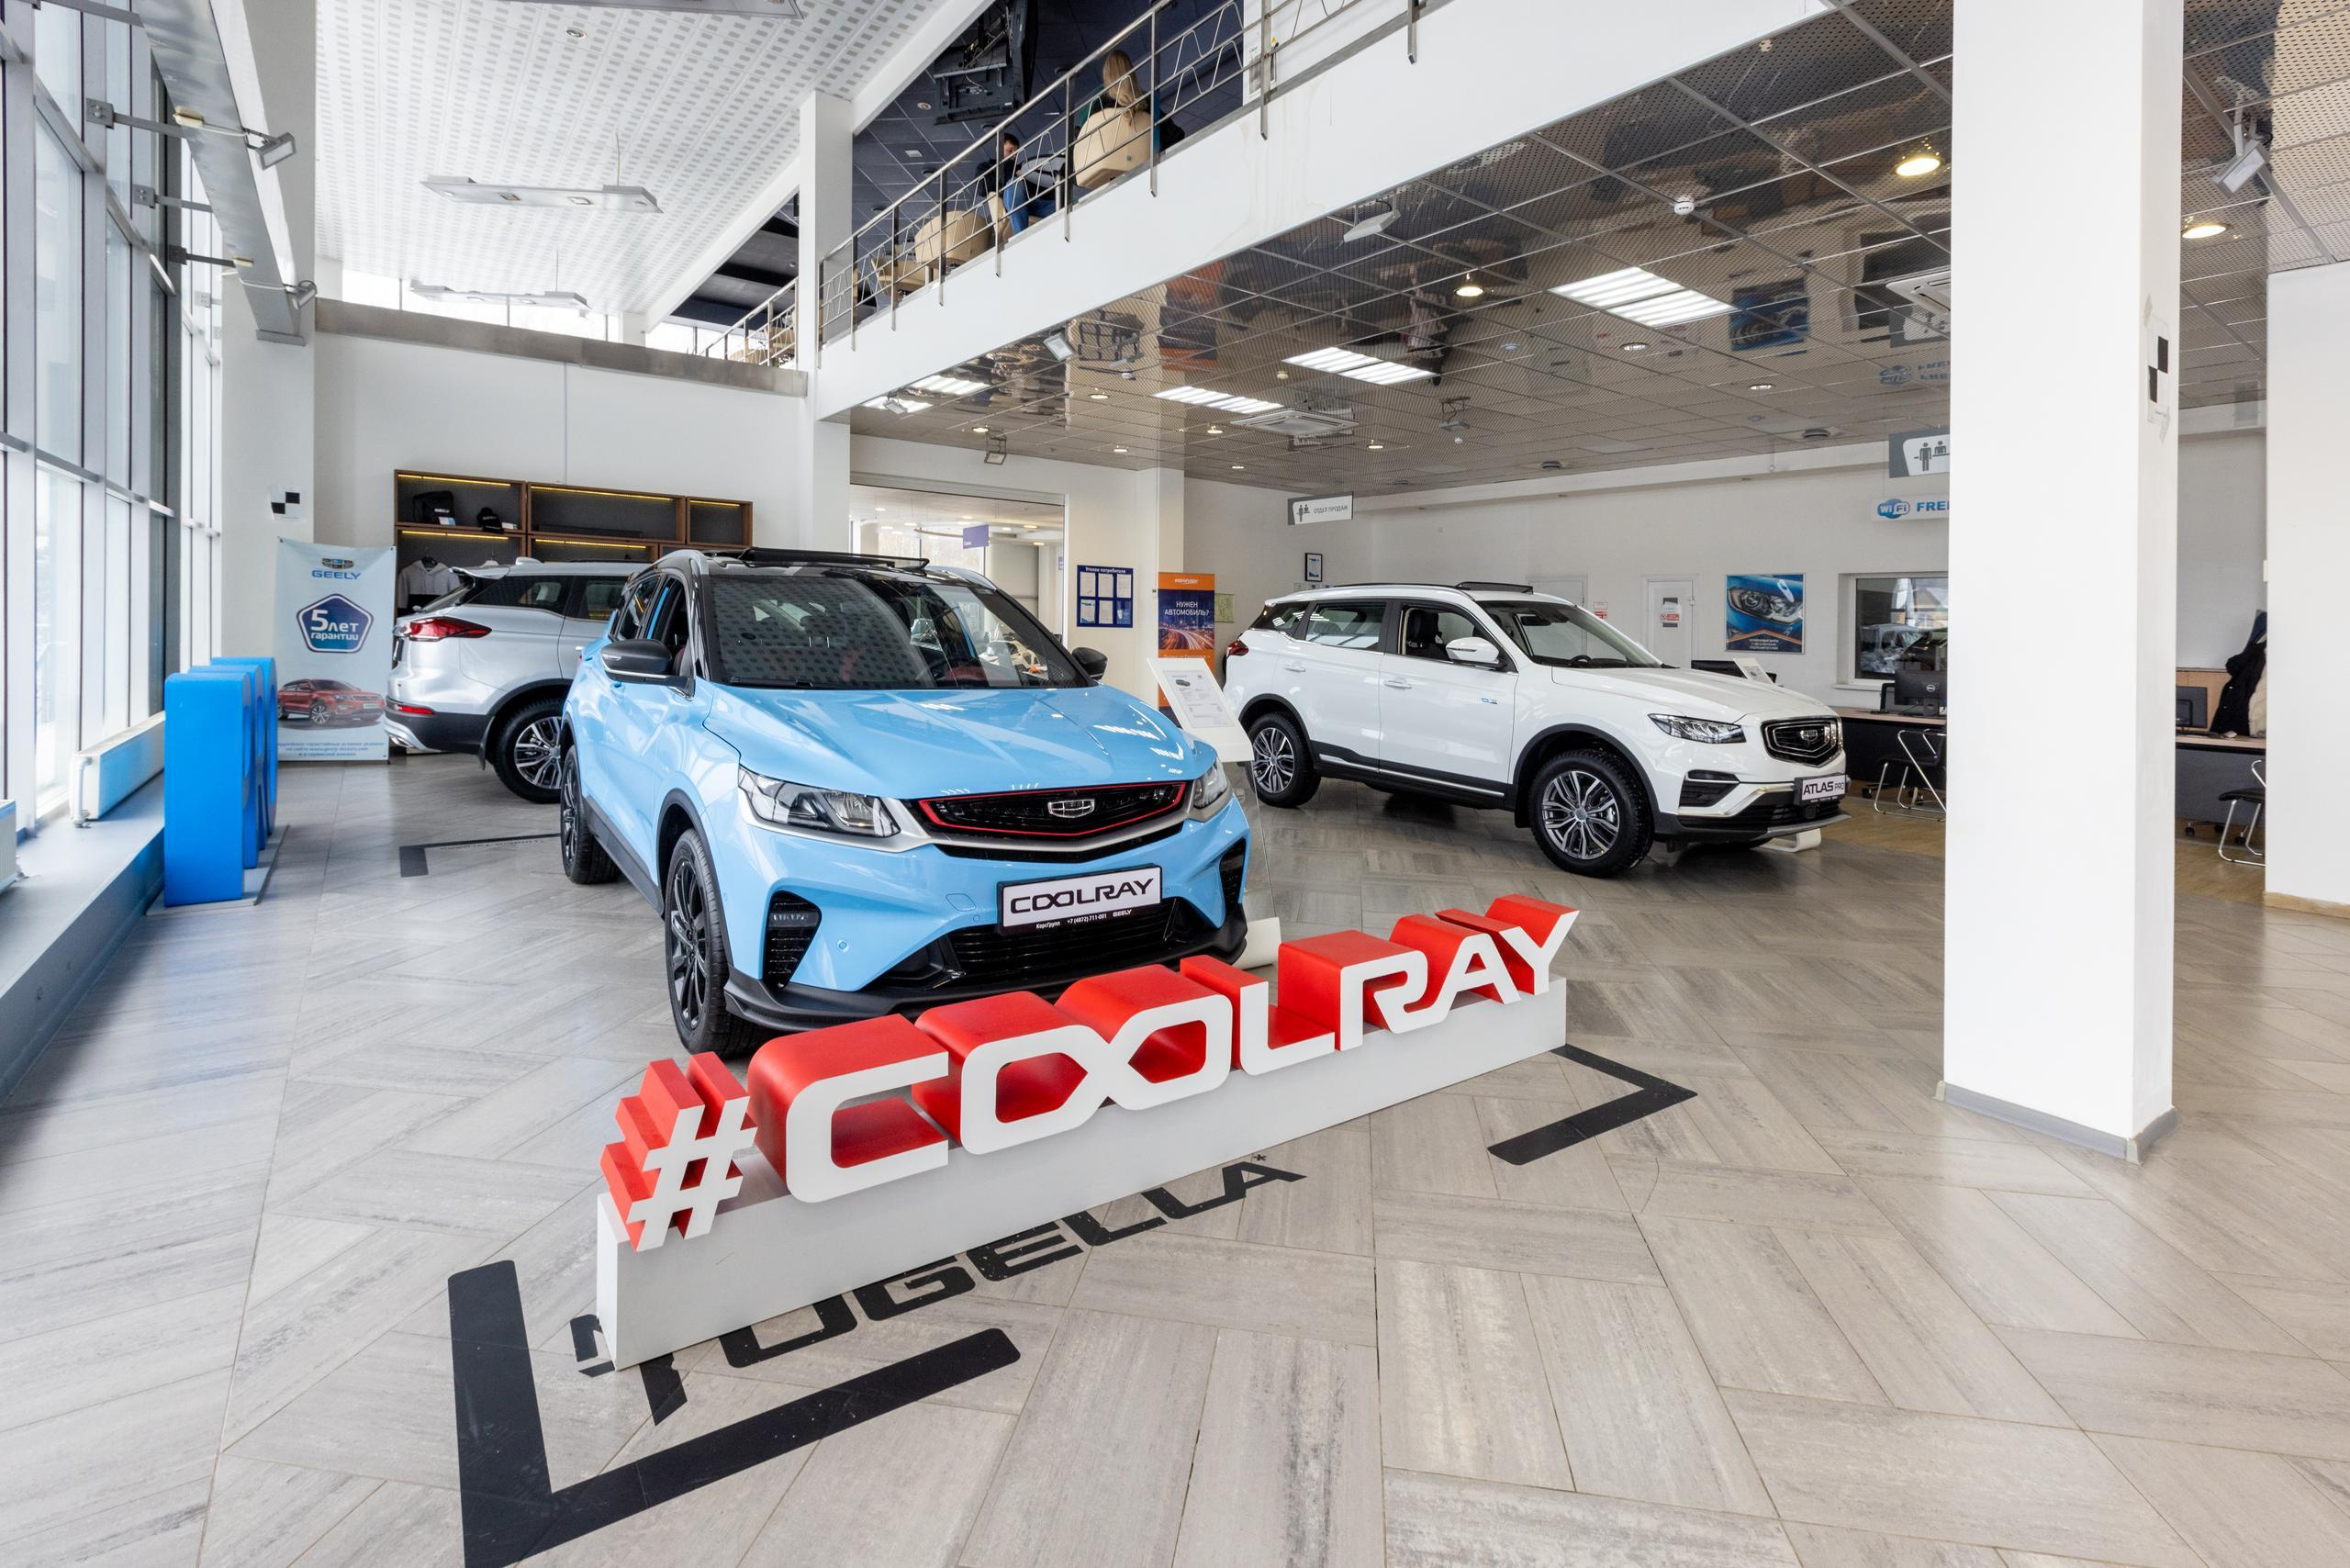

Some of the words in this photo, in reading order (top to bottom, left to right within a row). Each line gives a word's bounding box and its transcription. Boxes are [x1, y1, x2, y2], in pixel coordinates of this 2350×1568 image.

[1314, 506, 1328, 514] ОТДЕЛ
[1328, 505, 1348, 513] ПРОДАЖ
[1917, 500, 1950, 512] FRE
[312, 570, 362, 579] GEELY
[310, 633, 359, 641] гарантии
[1804, 781, 1834, 795] ATLAS
[1011, 879, 1154, 913] COOLRAY
[1035, 921, 1061, 929] КорсГрупп
[1074, 916, 1089, 924] (4872)
[1089, 913, 1107, 922] 711-001
[1113, 909, 1132, 917] GEELY
[613, 897, 1580, 1251] #COOLRAY
